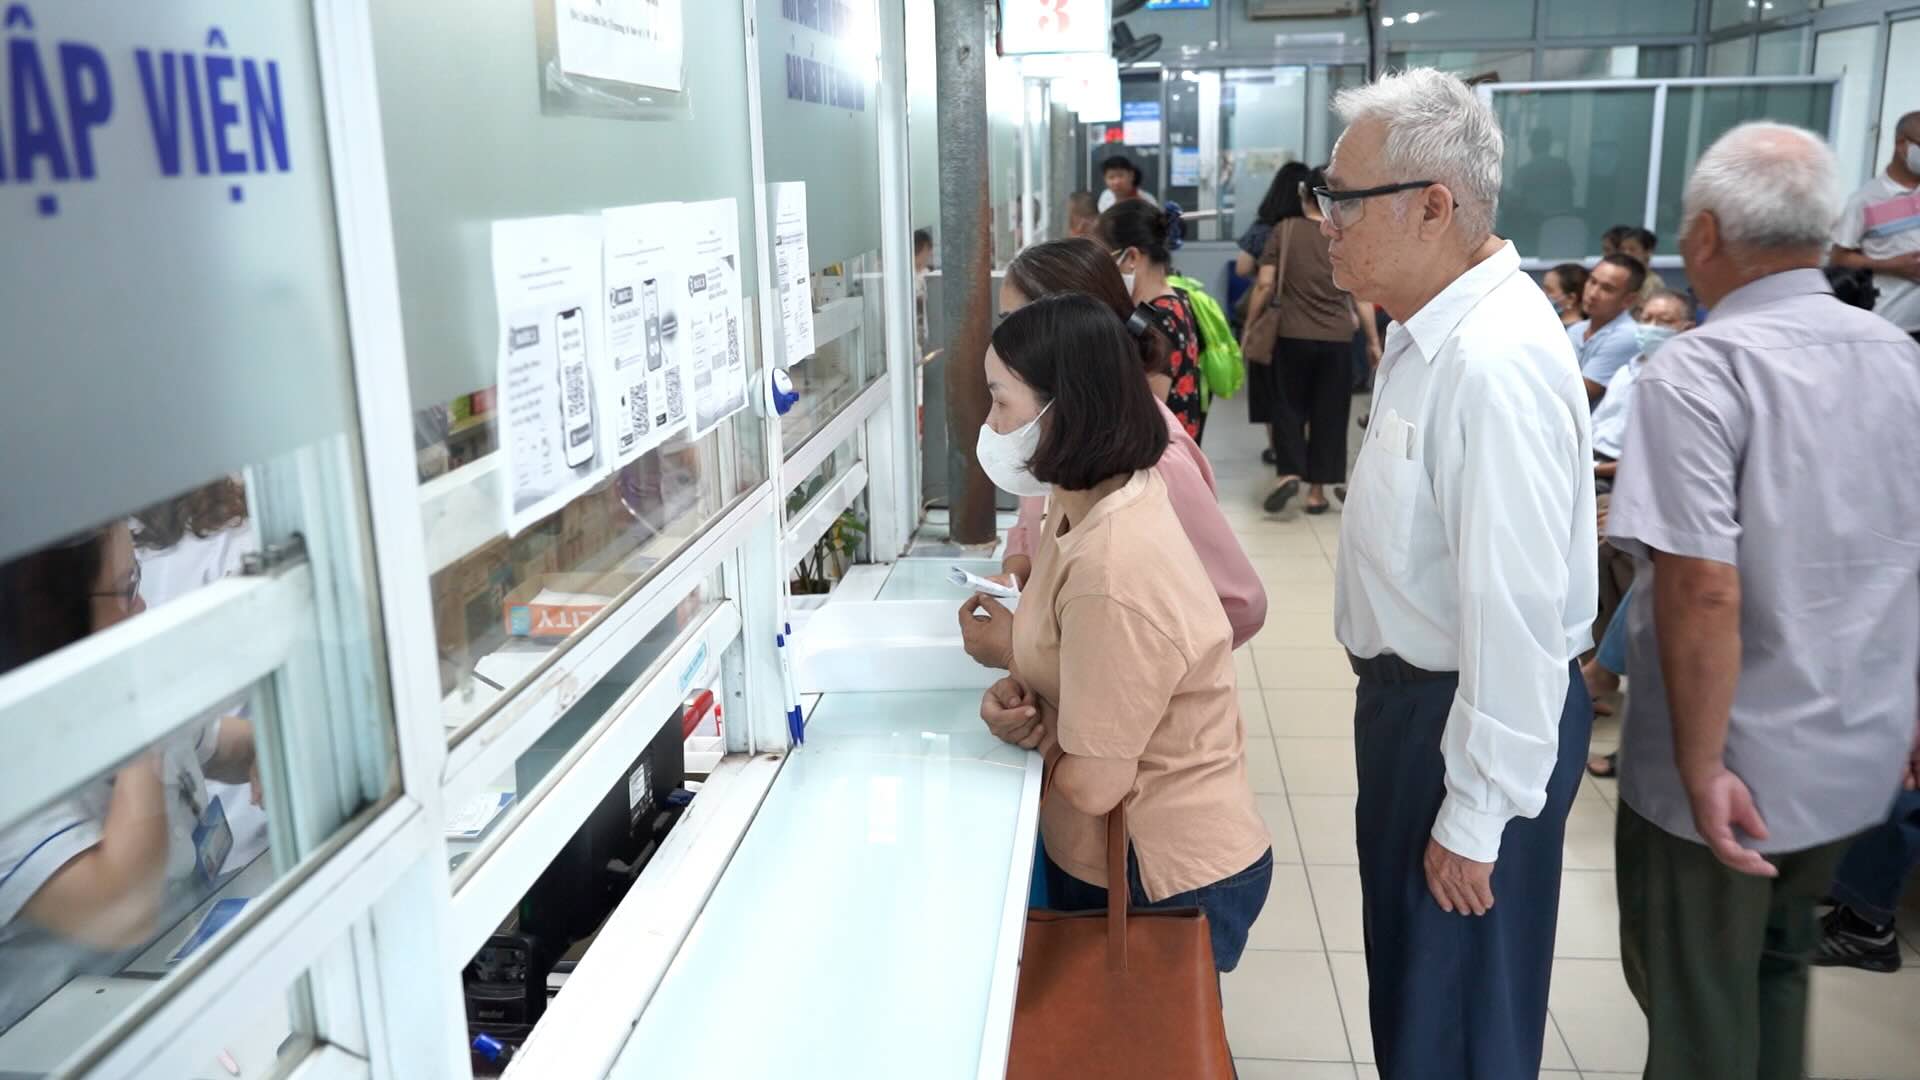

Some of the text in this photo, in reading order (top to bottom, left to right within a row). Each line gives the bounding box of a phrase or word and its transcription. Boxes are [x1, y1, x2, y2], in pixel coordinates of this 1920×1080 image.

[1039, 0, 1070, 33] 3
[0, 2, 292, 217] ẬP VIỆN
